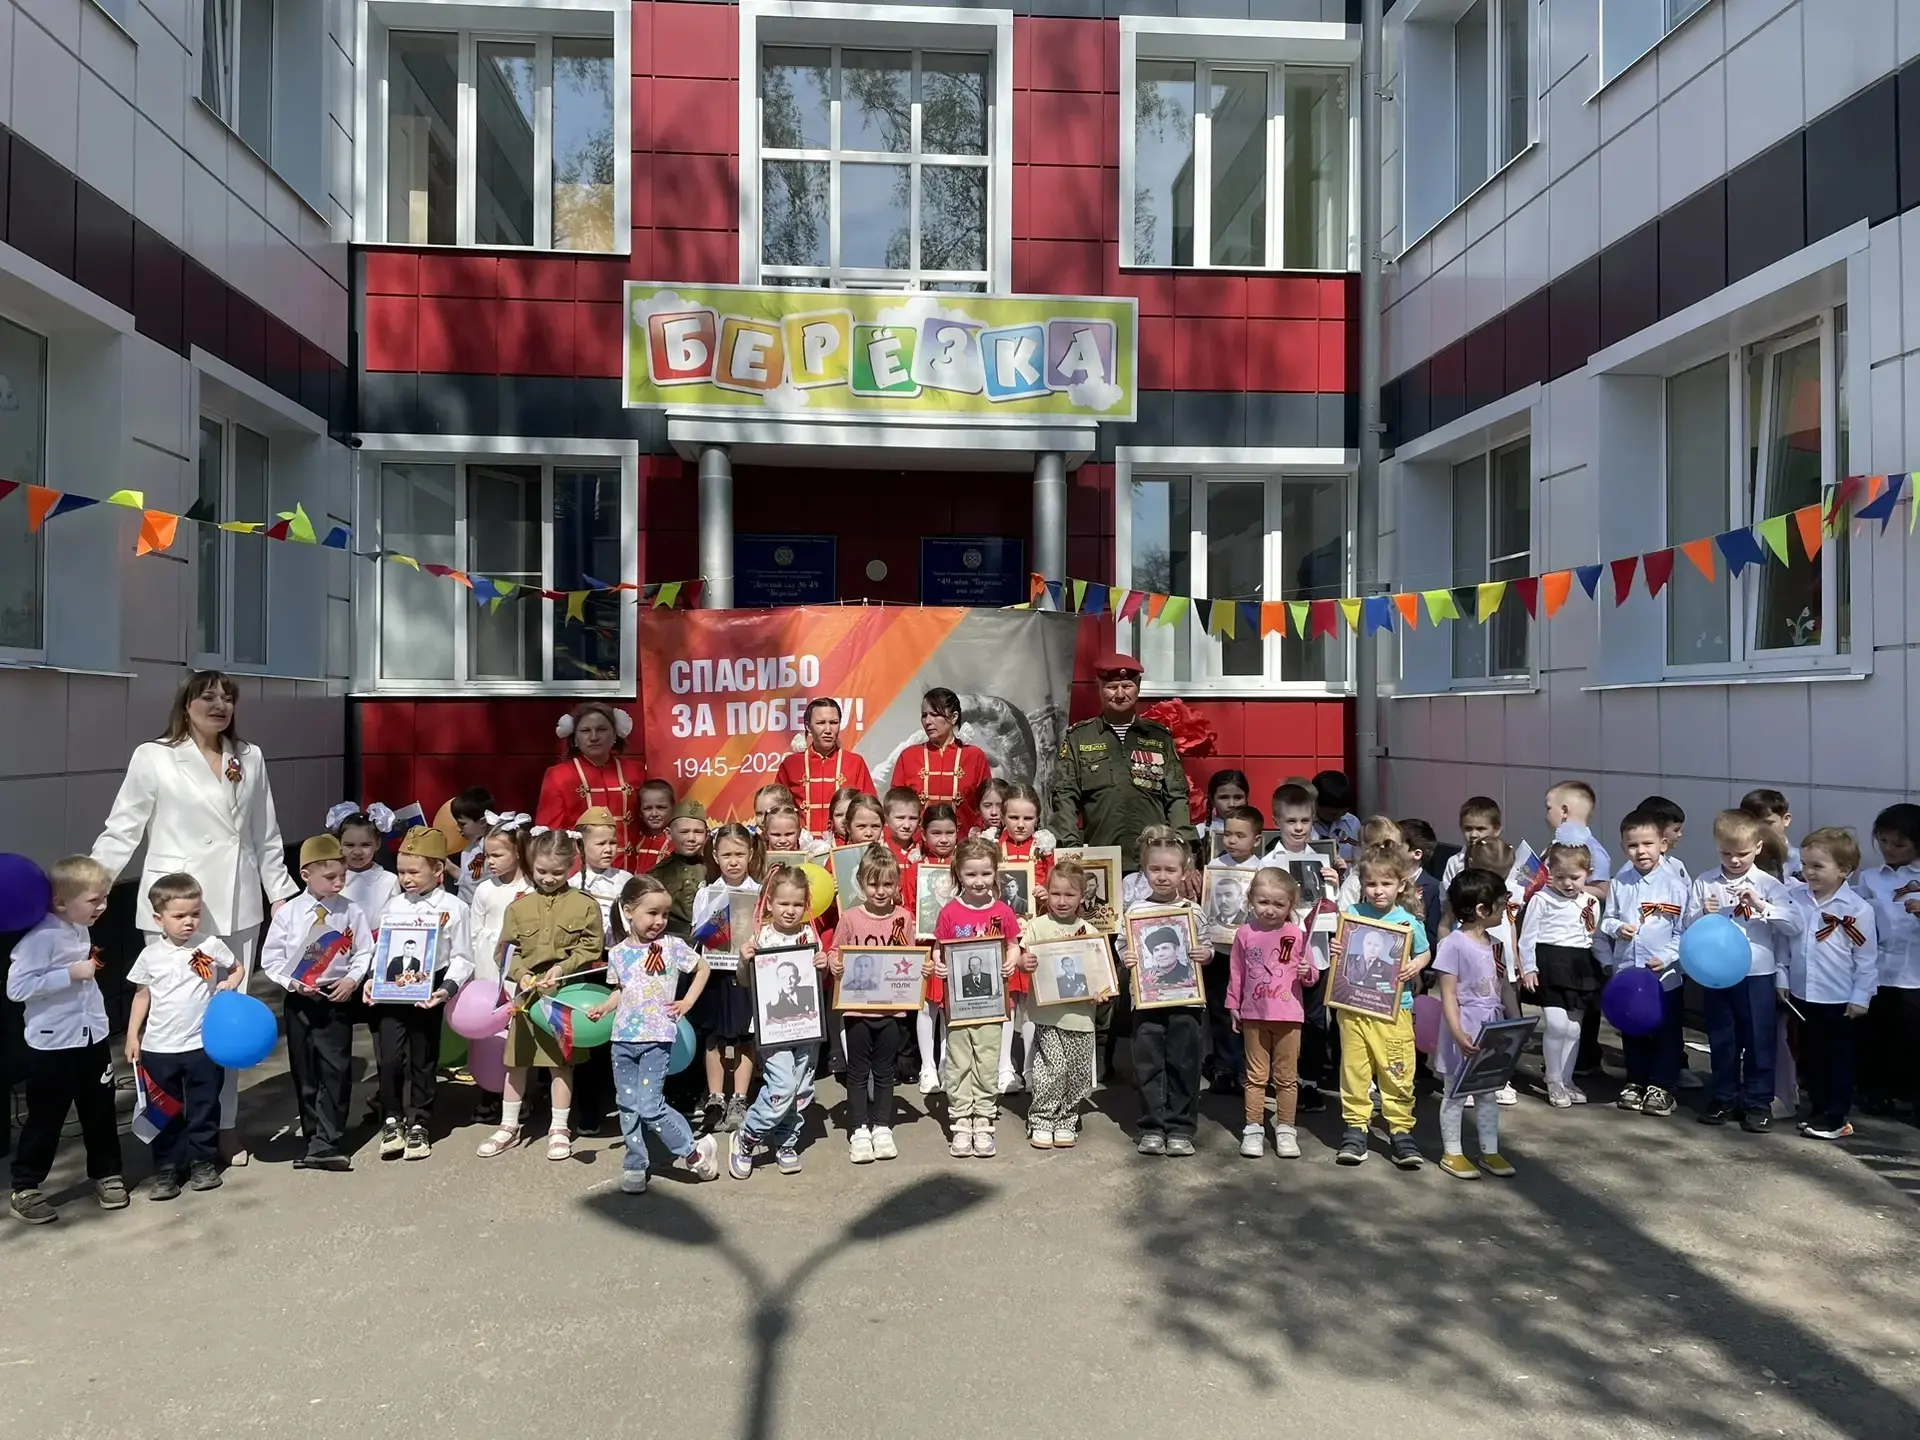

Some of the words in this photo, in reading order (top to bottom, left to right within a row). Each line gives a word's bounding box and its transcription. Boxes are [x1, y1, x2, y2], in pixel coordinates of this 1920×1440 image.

[662, 315, 1106, 391] БЕРЁЗКА
[669, 654, 821, 695] СПАСИБО
[671, 702, 717, 739] ЗА
[725, 697, 865, 737] ПОБЕУ!
[672, 752, 791, 779] 1945–202
[1252, 982, 1283, 1001] Girl
